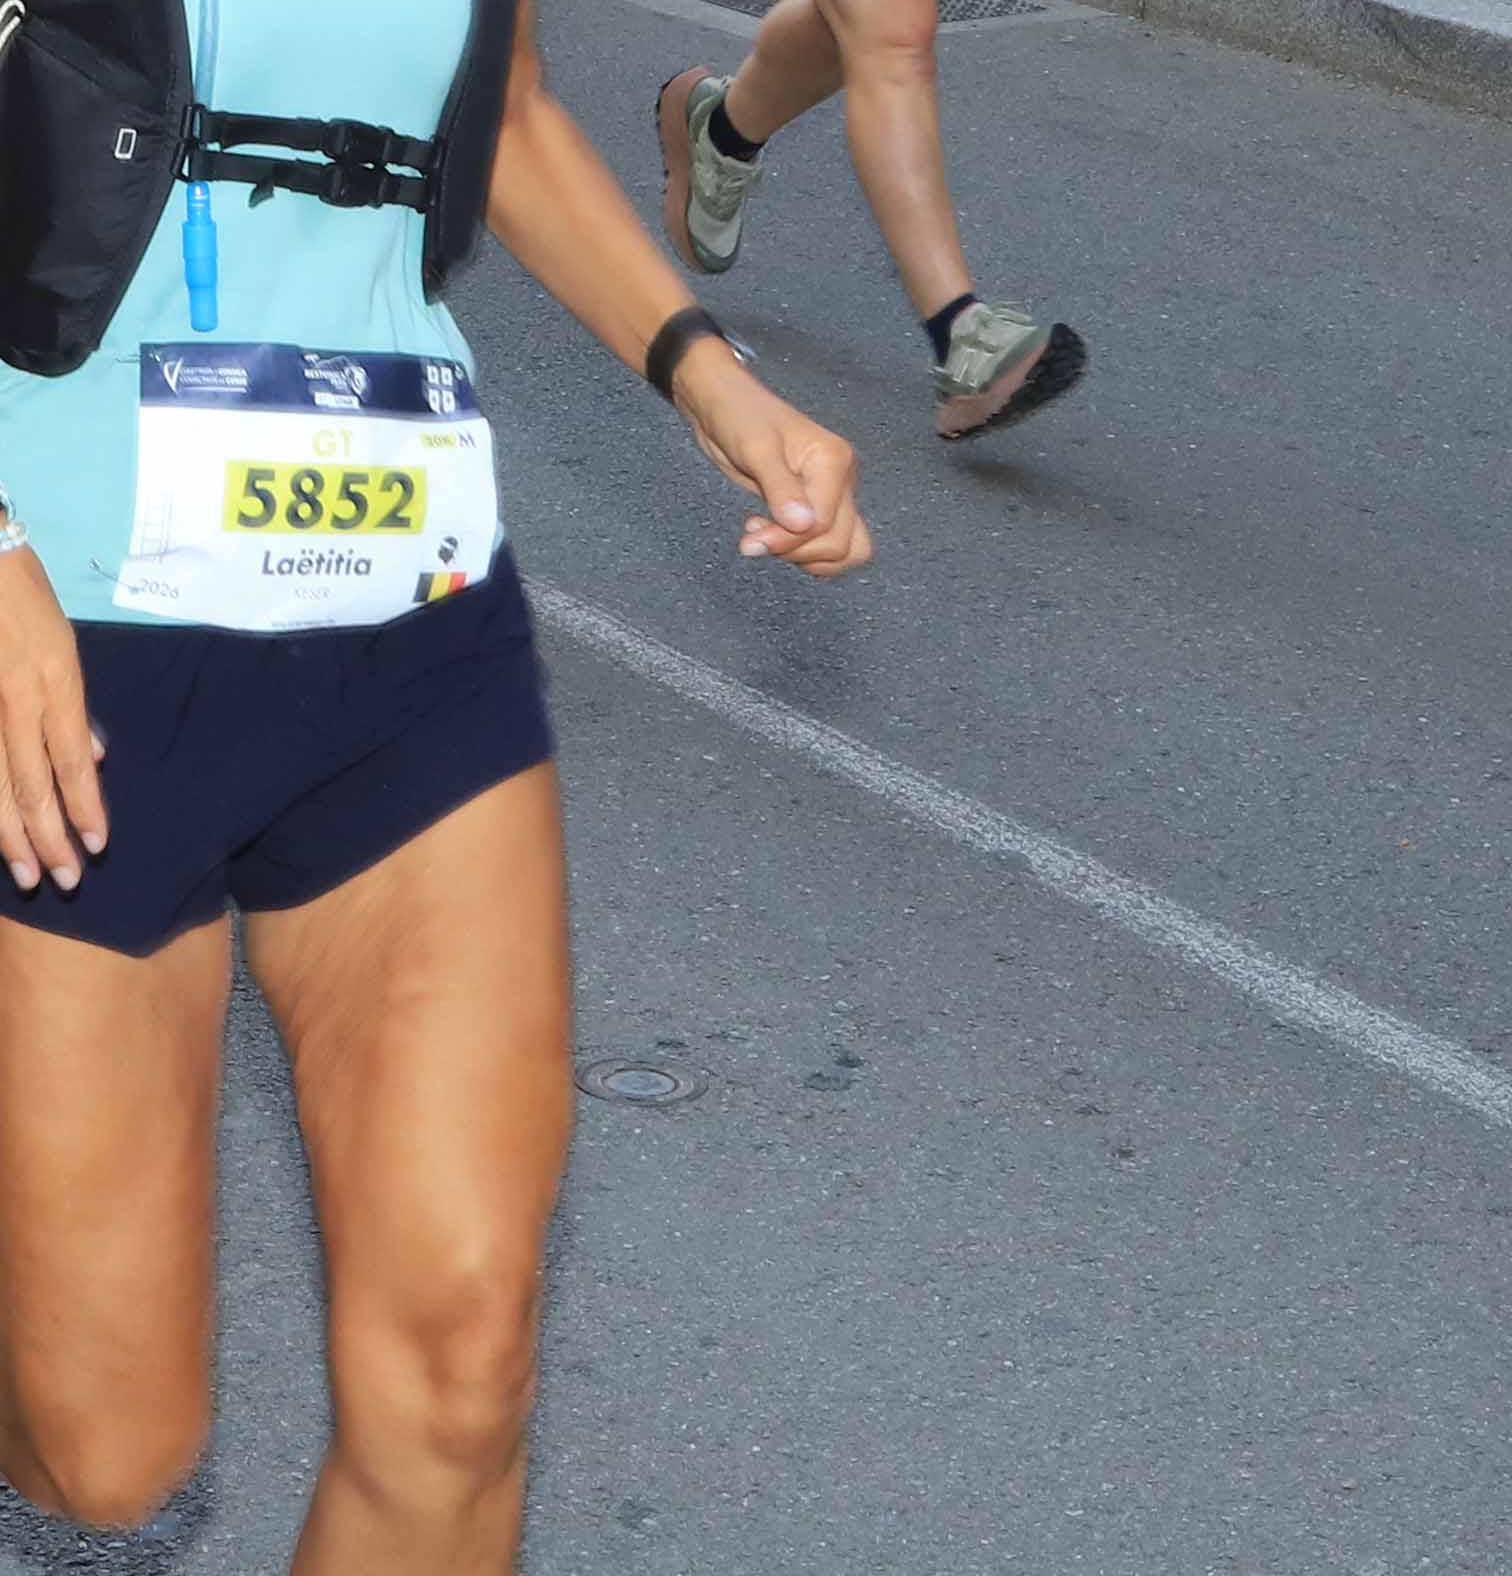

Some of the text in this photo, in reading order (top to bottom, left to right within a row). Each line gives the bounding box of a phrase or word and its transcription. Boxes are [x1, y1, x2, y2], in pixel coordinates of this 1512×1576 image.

[313, 430, 354, 457] GT
[237, 467, 415, 530] 5852
[262, 549, 373, 577] Laëtitia
[139, 576, 180, 600] 2026
